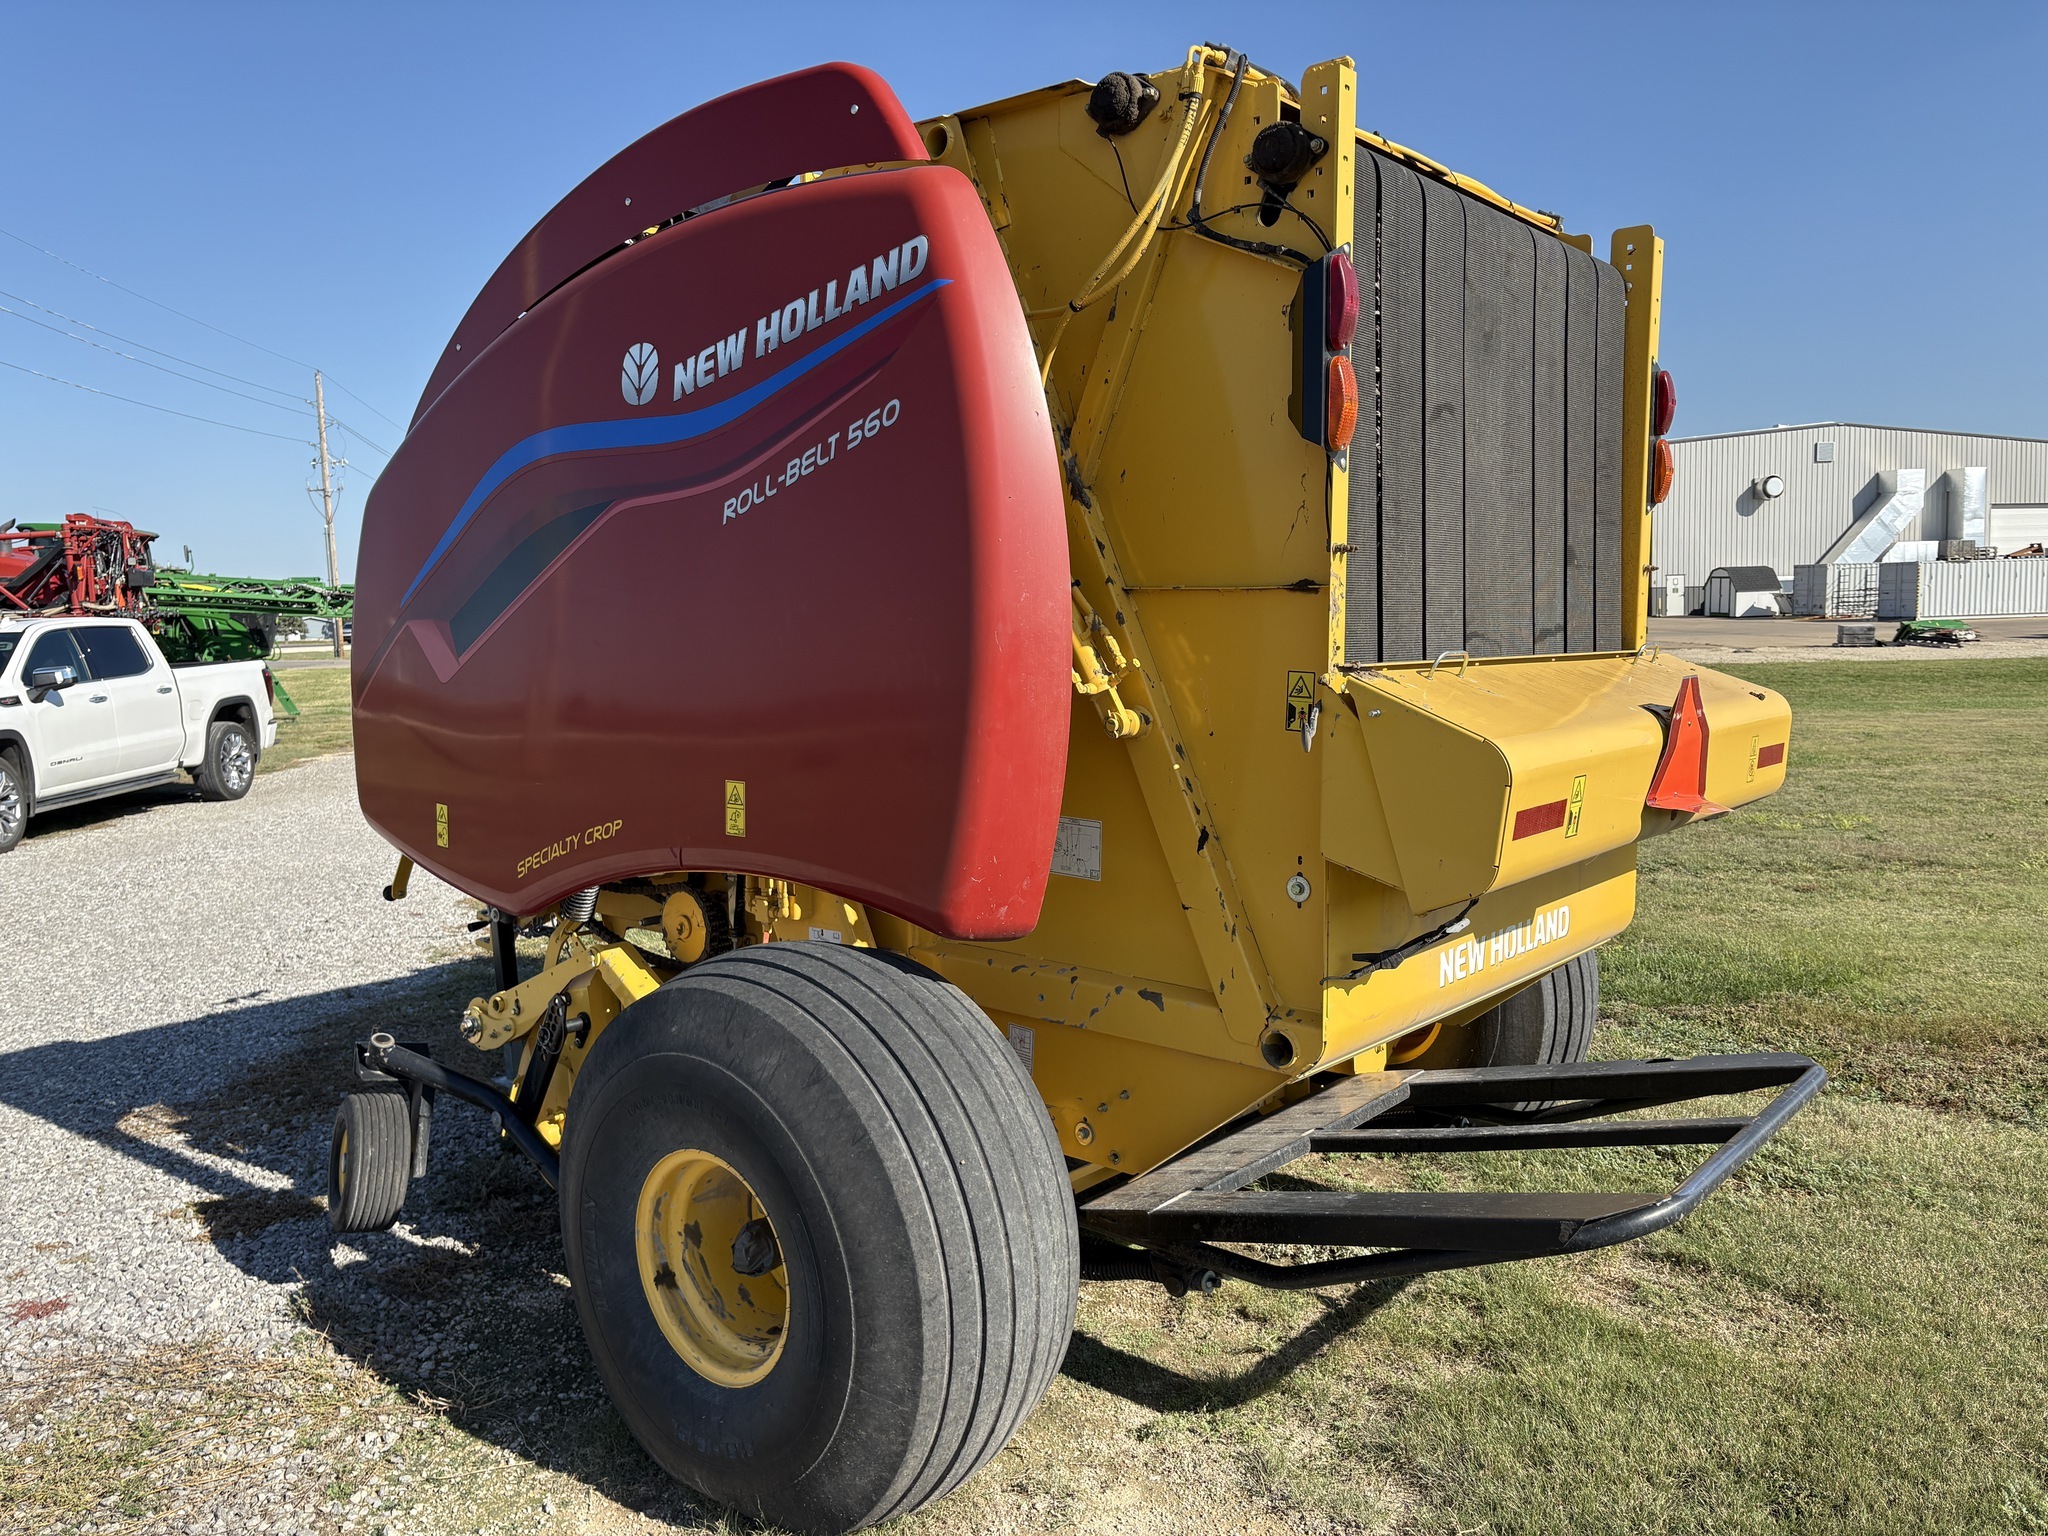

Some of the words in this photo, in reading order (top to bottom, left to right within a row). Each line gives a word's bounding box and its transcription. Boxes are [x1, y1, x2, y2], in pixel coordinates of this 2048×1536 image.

[673, 326, 748, 402] NEW
[755, 234, 929, 359] HOLLAND
[722, 431, 840, 526] ROLL-BELT
[847, 398, 901, 451] 560
[517, 832, 581, 879] SPECIALTY
[584, 819, 623, 845] CROP
[1439, 935, 1486, 989] NEW
[1490, 905, 1570, 967] HOLLAND
